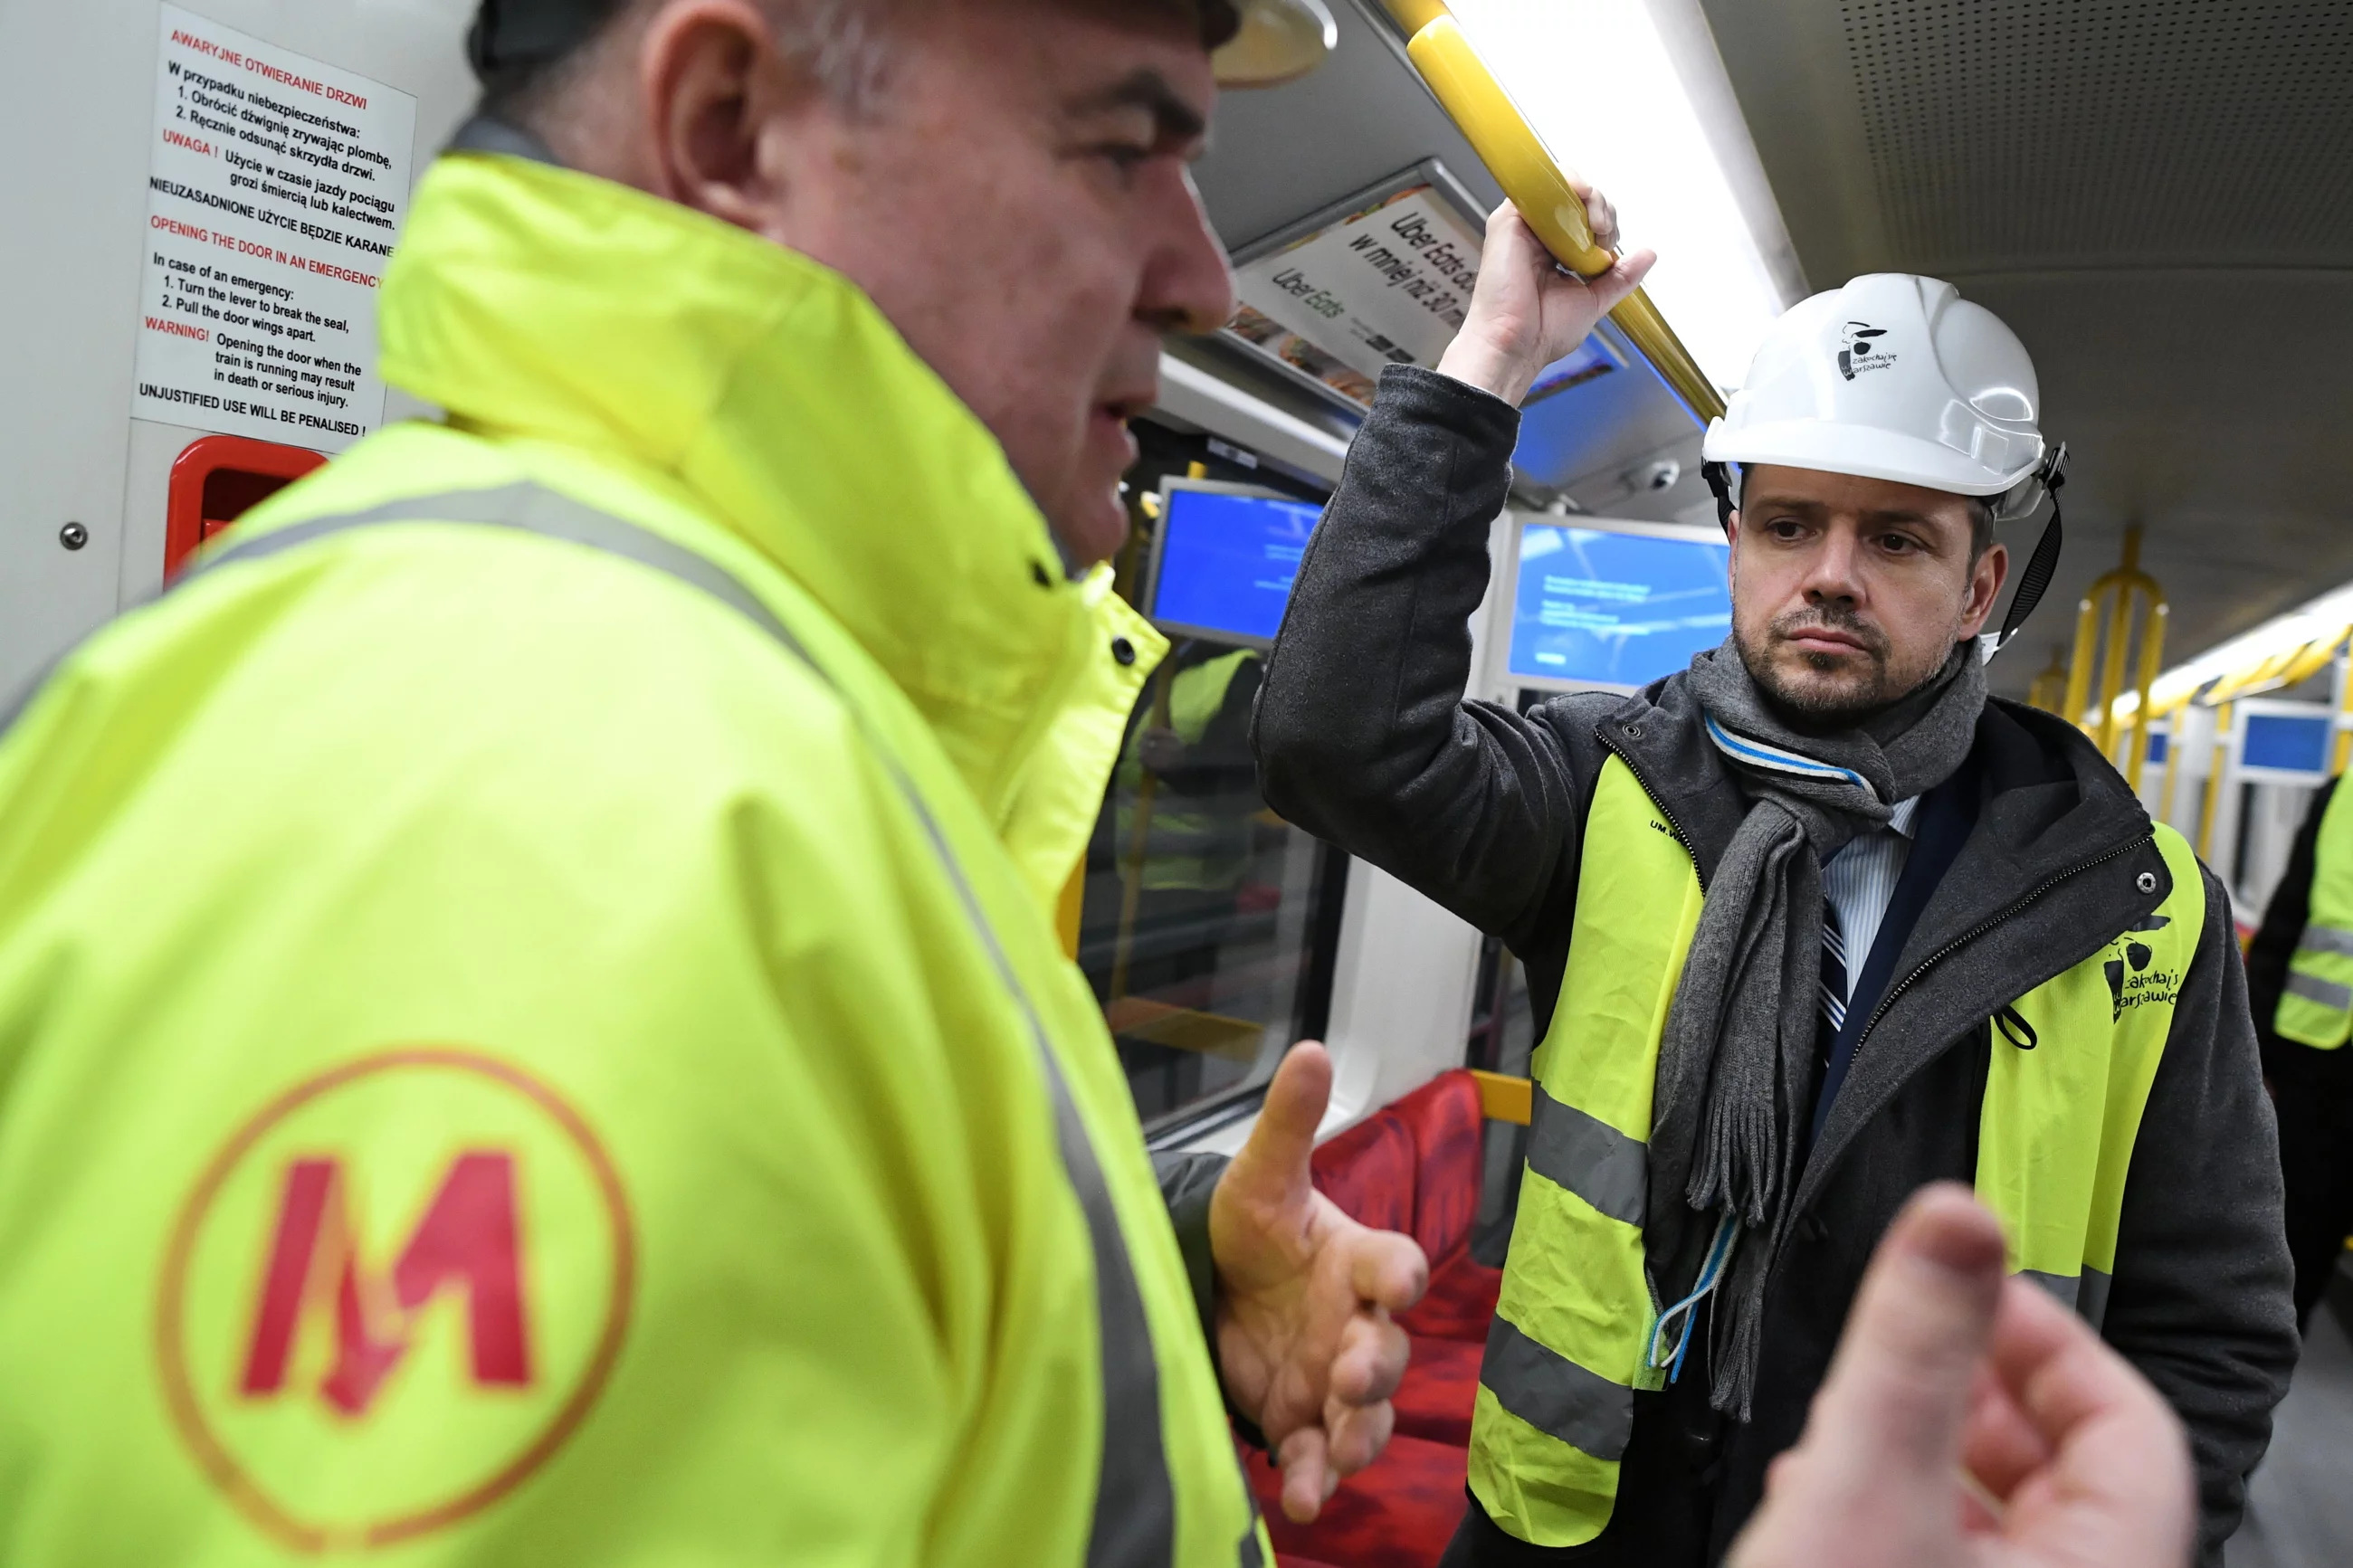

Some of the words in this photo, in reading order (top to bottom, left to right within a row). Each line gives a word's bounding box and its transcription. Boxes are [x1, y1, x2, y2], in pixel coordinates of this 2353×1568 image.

[171, 30, 242, 66] AWARYJNE
[245, 58, 322, 95] OTWIERANIE
[326, 87, 367, 109] DRZWI
[168, 60, 180, 75] W
[184, 69, 244, 100] przypadku
[248, 93, 360, 138] niebezpieczeństwa:
[163, 128, 210, 157] UWAGA
[176, 105, 186, 119] 2.
[190, 109, 235, 136] Ręcznie
[240, 128, 287, 155] odsunąć
[291, 147, 338, 170] skrzydła
[341, 162, 375, 181] drzwi.
[178, 85, 186, 100] 1.
[192, 90, 237, 117] Obrócić
[241, 108, 290, 138] dźwignię
[292, 128, 344, 156] zrywając
[348, 144, 392, 169] plombę,
[225, 149, 262, 173] Użycie
[266, 165, 274, 176] w
[278, 168, 312, 188] czasie
[314, 180, 347, 201] jazdy
[349, 187, 395, 214] pociągu
[230, 173, 258, 191] grozi
[261, 180, 307, 208] śmiercią
[310, 196, 329, 211] lub
[332, 203, 395, 230] kalectwem.
[149, 176, 254, 218] NIEUZASADNIONE
[258, 209, 297, 231] UŻYCIE
[300, 222, 342, 243] BĘDZIE
[346, 233, 395, 257] KARANE
[150, 215, 207, 242] OPENING
[212, 233, 235, 250] THE
[238, 241, 272, 260] DOOR
[275, 251, 287, 263] IN
[290, 255, 306, 269] AN
[1391, 212, 1438, 250] Uber
[1424, 242, 1464, 276] Eats
[154, 252, 165, 265] In
[168, 257, 195, 274] case
[199, 266, 212, 278] of
[214, 270, 227, 282] an
[231, 274, 294, 300] emergency:
[1272, 268, 1315, 297] Uber
[1304, 290, 1345, 318] Eats
[162, 295, 172, 307] 2.
[176, 298, 198, 314] Pull
[203, 306, 220, 319] the
[224, 310, 249, 328] door
[252, 318, 283, 337] wings
[287, 327, 316, 343] apart.
[164, 276, 174, 288] 1.
[177, 278, 205, 296] Turn
[208, 286, 226, 301] the
[230, 291, 256, 310] lever
[260, 299, 271, 311] to
[273, 301, 302, 320] break
[305, 311, 321, 324] the
[324, 316, 349, 334] seal,
[215, 351, 241, 367] train
[243, 357, 253, 369] is
[256, 361, 298, 382] running
[300, 371, 322, 388] may
[325, 375, 355, 392] result
[216, 333, 263, 357] Opening
[267, 345, 283, 358] the
[287, 348, 311, 365] door
[314, 356, 341, 372] when
[344, 363, 361, 376] the
[139, 383, 220, 409] UNJUSTIFIED
[224, 399, 246, 414] USE
[250, 404, 277, 421] WILL
[281, 411, 296, 423] BE
[299, 415, 359, 436] PENALISED
[214, 368, 224, 381] in
[228, 372, 258, 388] death
[262, 380, 273, 391] or
[275, 384, 314, 400] serious
[317, 391, 348, 408] injury.
